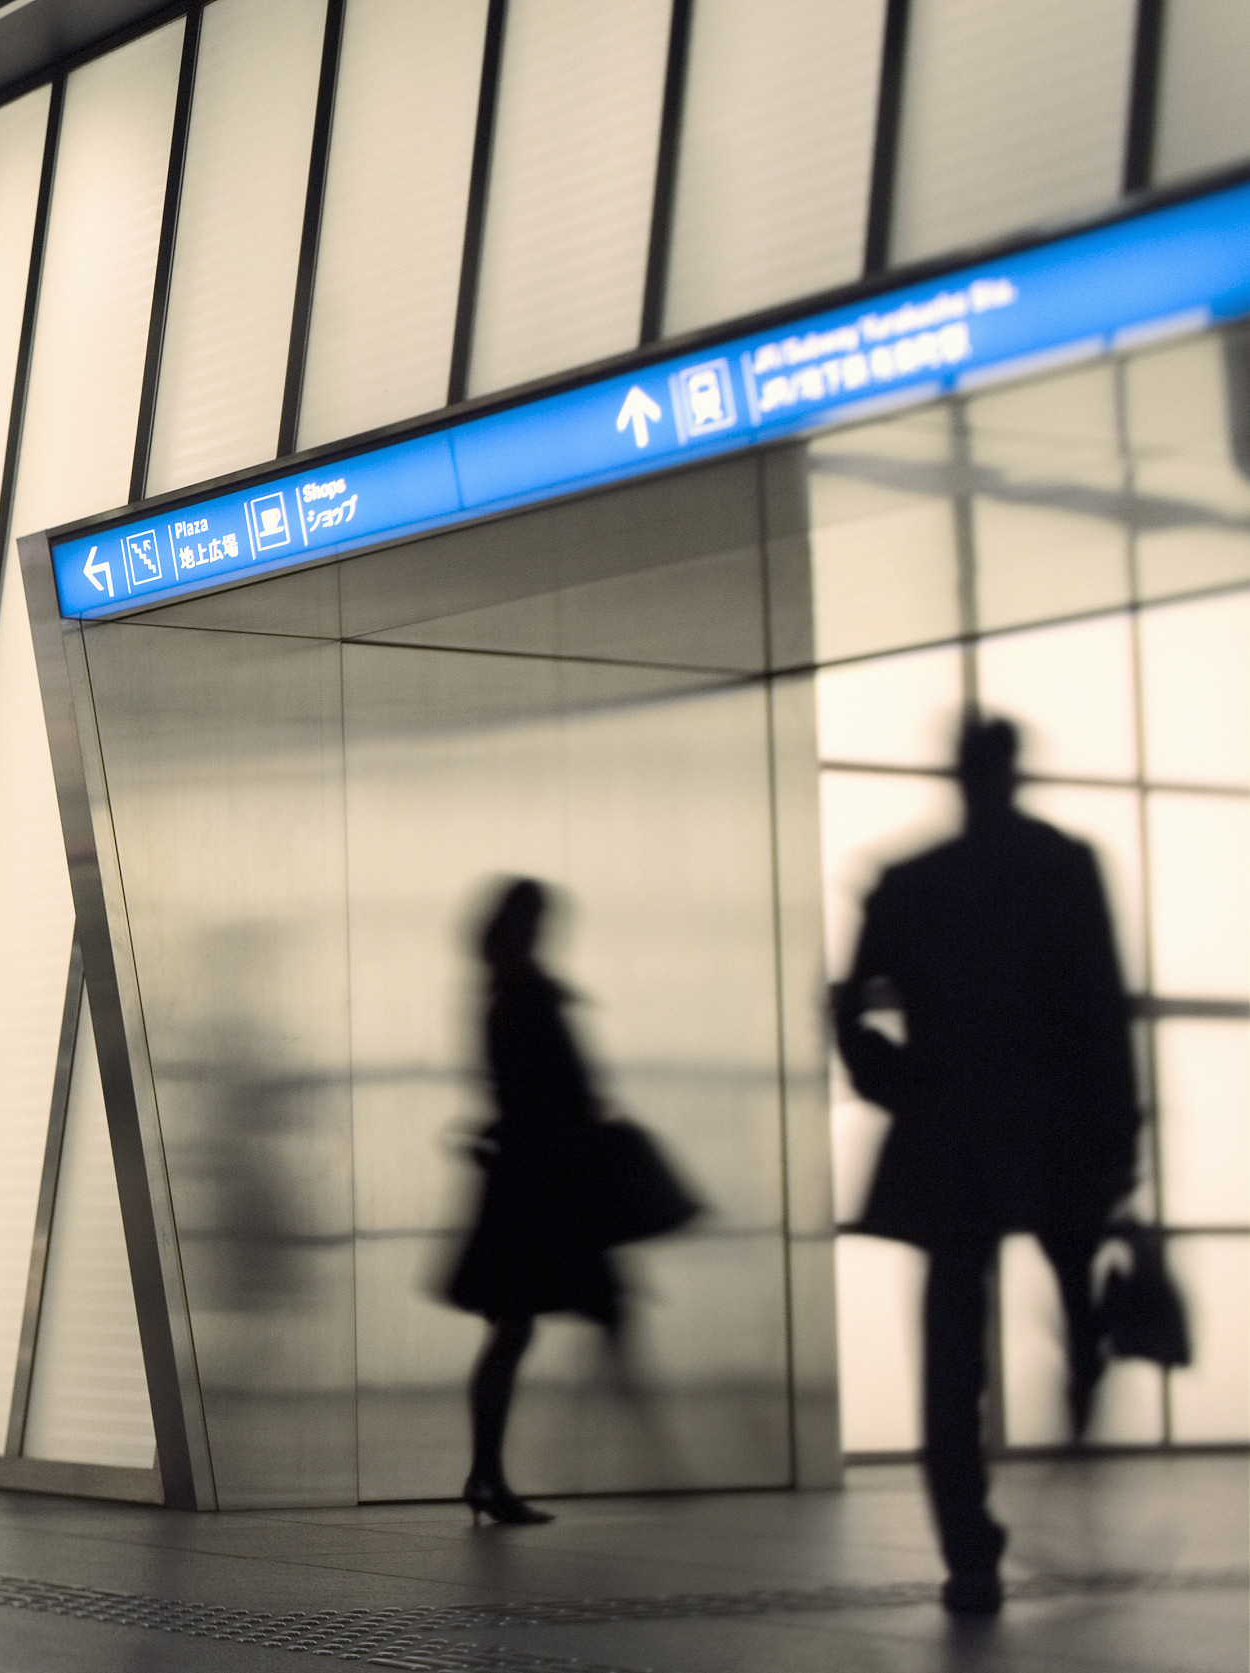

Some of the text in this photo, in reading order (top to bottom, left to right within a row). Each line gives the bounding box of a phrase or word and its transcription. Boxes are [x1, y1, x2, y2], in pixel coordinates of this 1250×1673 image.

[302, 478, 346, 503] Shops
[175, 517, 208, 539] Plaza
[306, 494, 358, 532] ショップ
[178, 533, 239, 570] 地上広場
